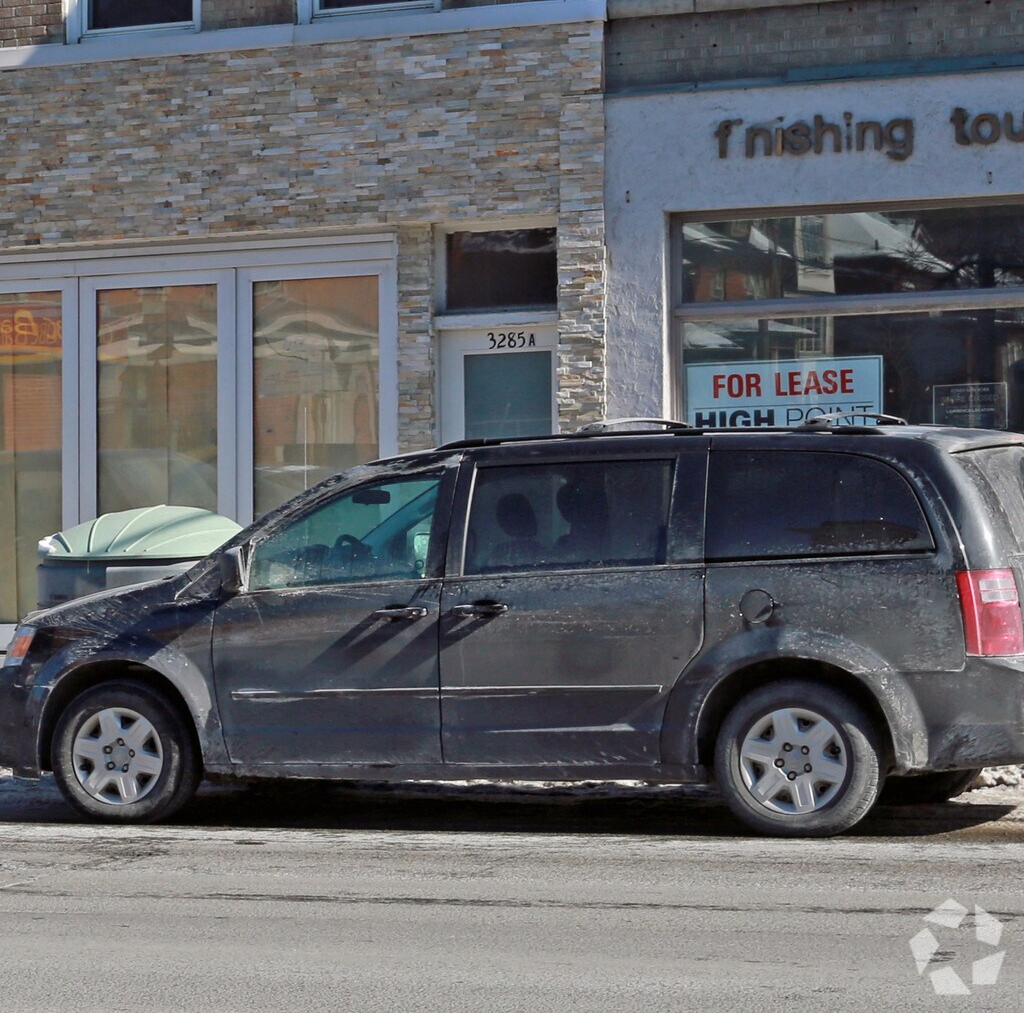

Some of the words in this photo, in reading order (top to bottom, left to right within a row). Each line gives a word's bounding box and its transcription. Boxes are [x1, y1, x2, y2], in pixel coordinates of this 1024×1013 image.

[487, 331, 536, 350] 3285A
[712, 372, 762, 399] FOR
[775, 369, 854, 397] LEASE
[695, 409, 775, 428] HIGH
